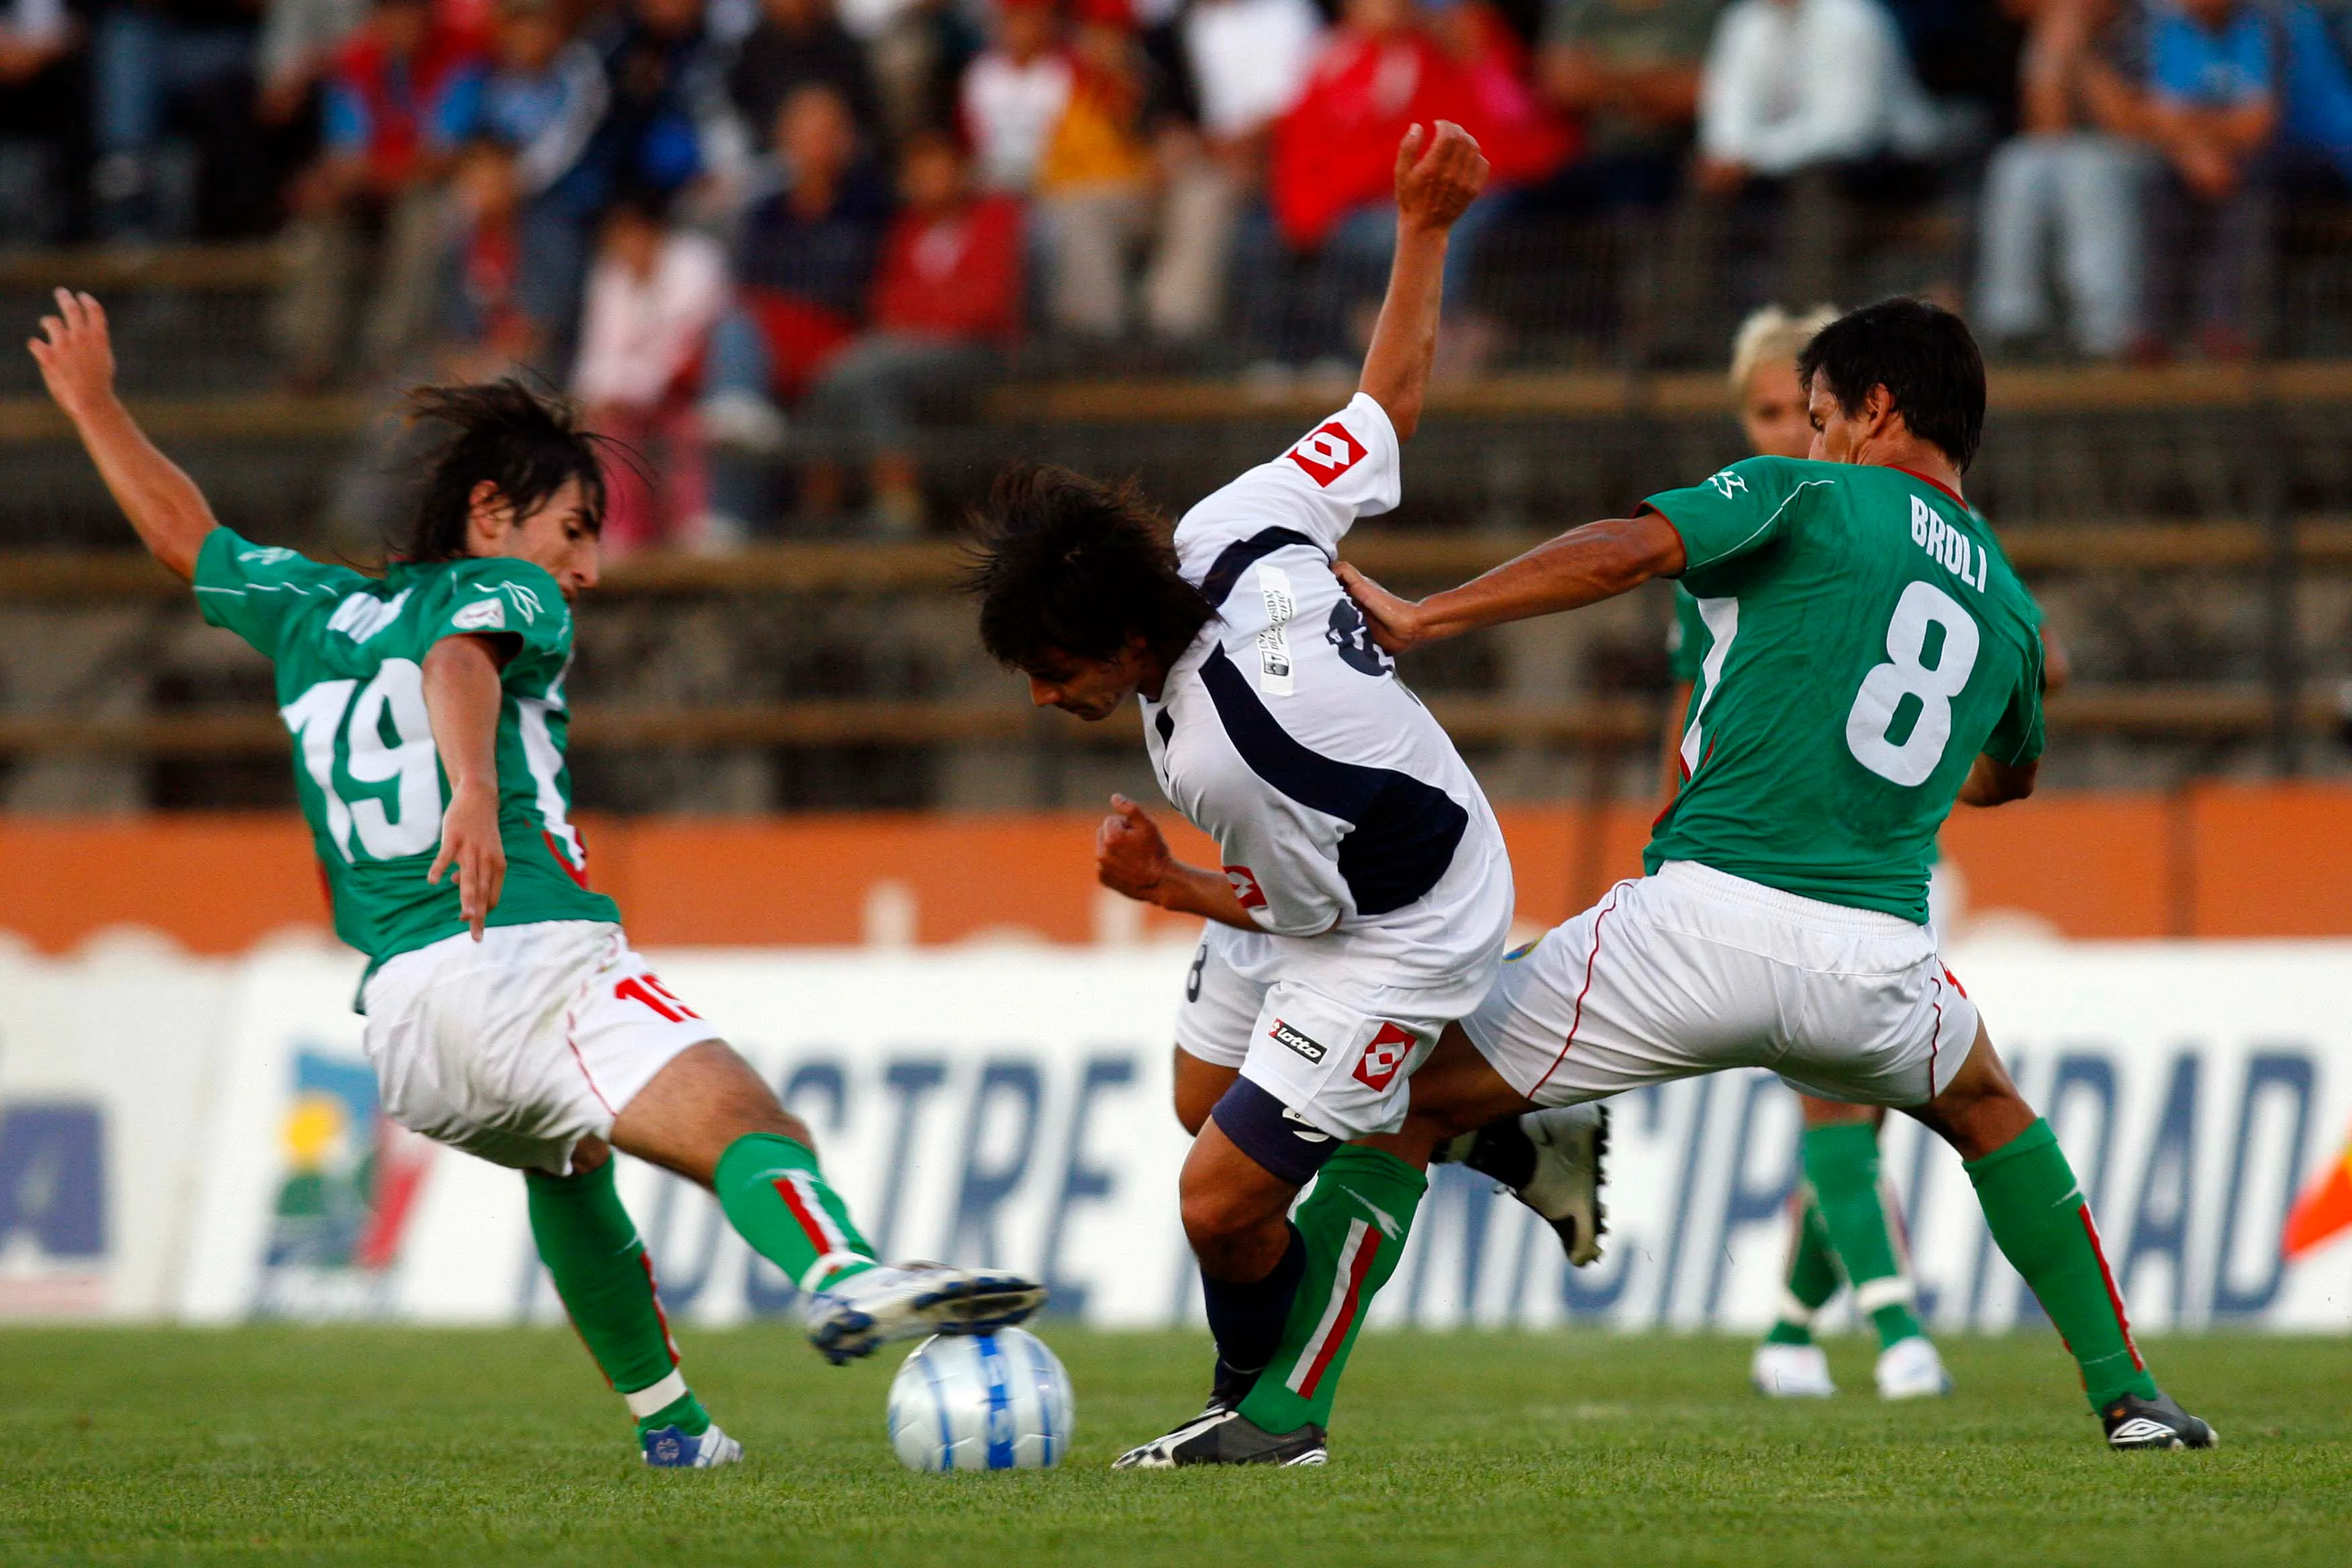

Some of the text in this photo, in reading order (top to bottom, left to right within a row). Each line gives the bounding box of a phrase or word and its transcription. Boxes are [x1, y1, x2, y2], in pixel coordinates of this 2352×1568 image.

[1910, 494, 1988, 593] BROLI
[1846, 581, 1979, 787] 8
[279, 657, 443, 864] 19
[1277, 1028, 1321, 1058] lotto
